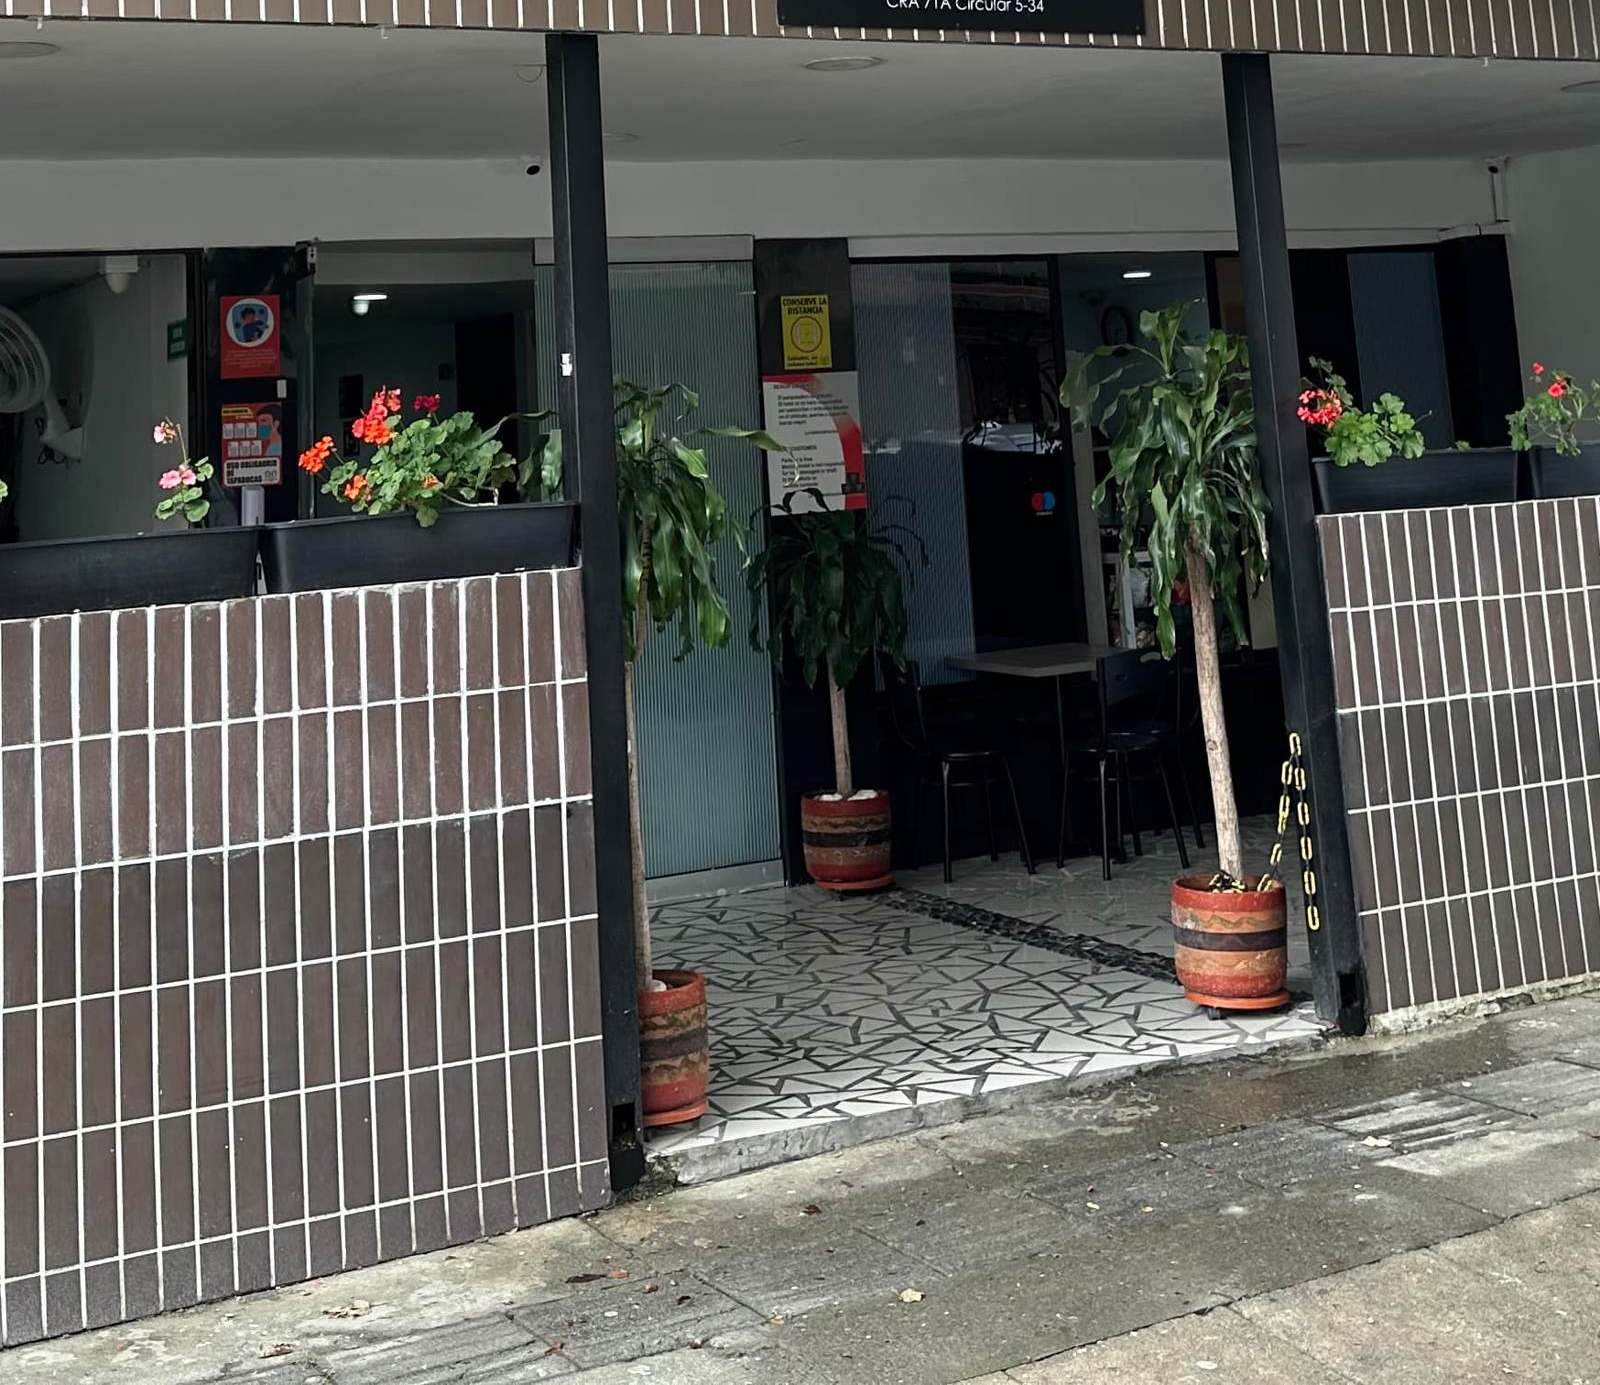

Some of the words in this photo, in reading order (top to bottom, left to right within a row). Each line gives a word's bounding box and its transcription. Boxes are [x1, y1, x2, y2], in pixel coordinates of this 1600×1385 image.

[782, 297, 817, 307] CONSERVE
[818, 297, 828, 305] LA
[787, 306, 824, 315] DISTANCIA
